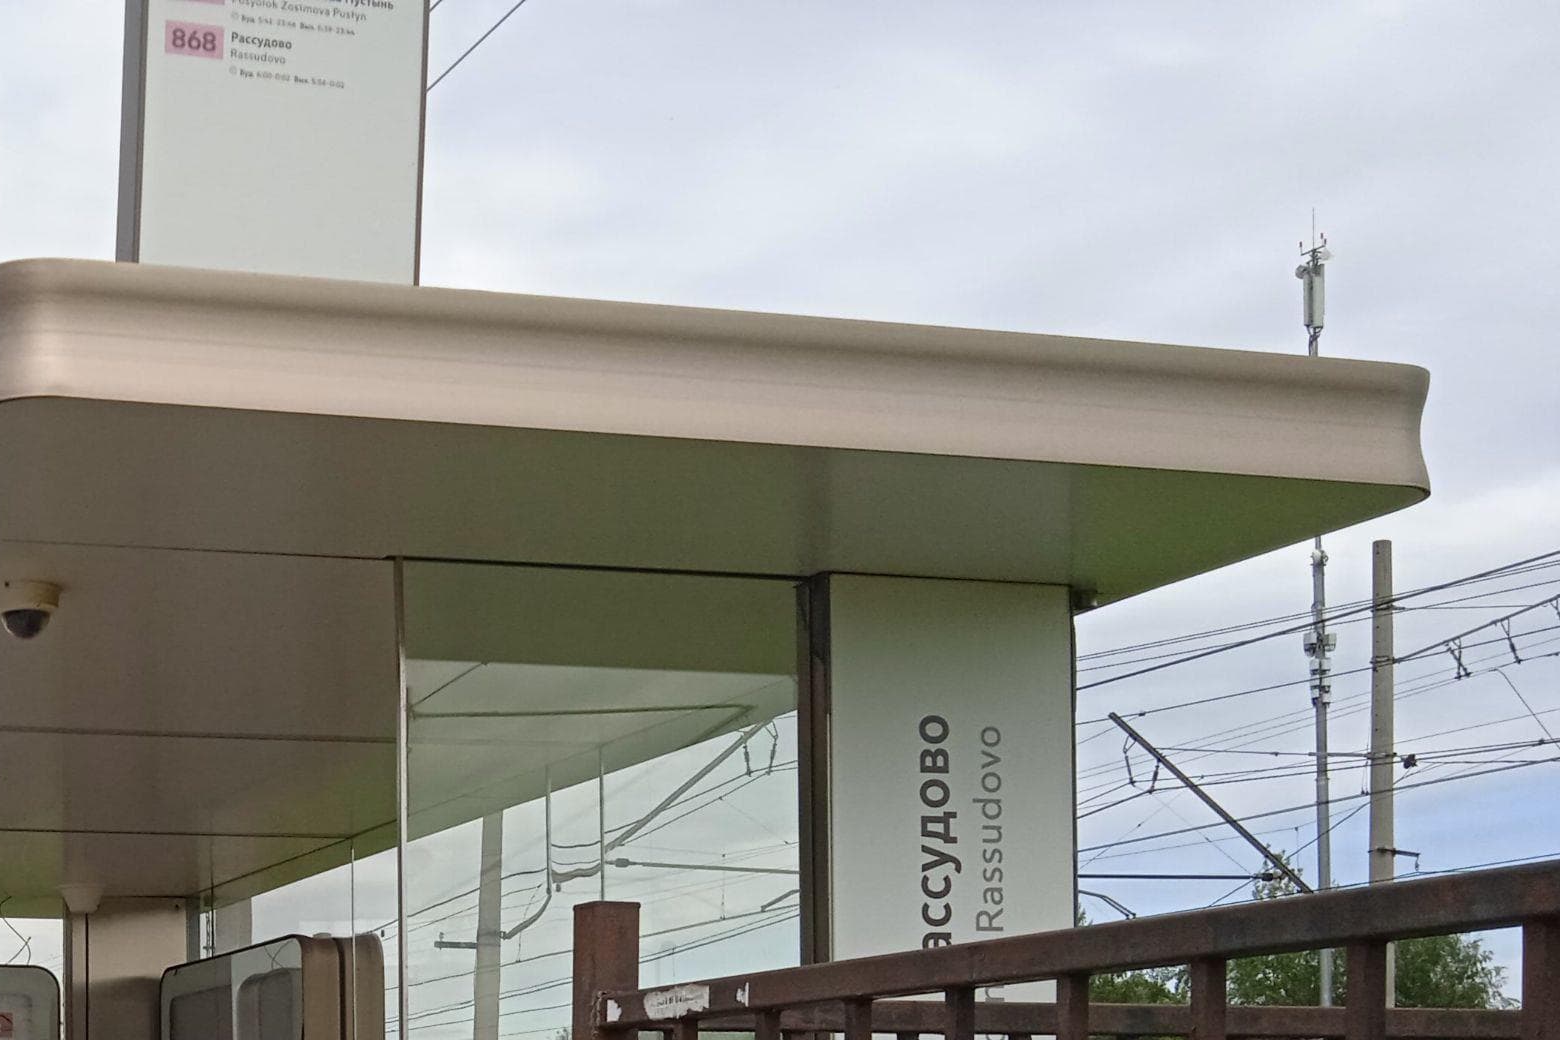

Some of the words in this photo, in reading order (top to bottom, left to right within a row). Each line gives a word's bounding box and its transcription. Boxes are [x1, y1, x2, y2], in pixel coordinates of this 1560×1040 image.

[281, 3, 331, 17] Zosimova
[333, 8, 368, 22] Pustyn
[172, 28, 216, 51] 868
[231, 31, 293, 50] Рассудово
[230, 49, 286, 65] Rassudovo
[919, 715, 961, 950] ассудово
[972, 726, 1004, 932] Rassudovo
